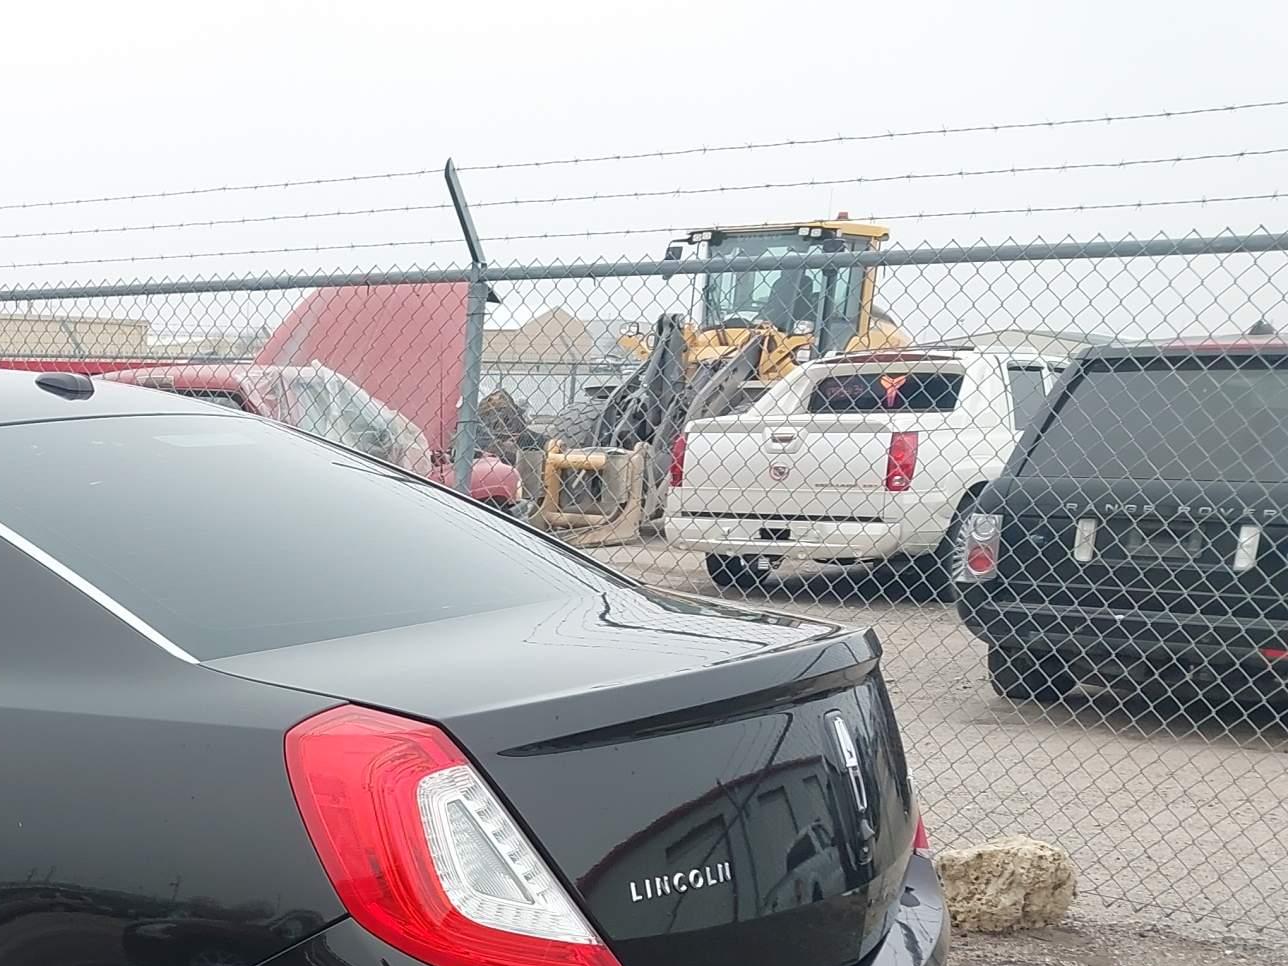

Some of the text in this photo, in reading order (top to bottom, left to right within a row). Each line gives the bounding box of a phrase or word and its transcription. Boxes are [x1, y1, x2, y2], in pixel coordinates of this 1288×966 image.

[1065, 502, 1277, 517] RANGE ROVER
[629, 861, 732, 903] LINCOLN
